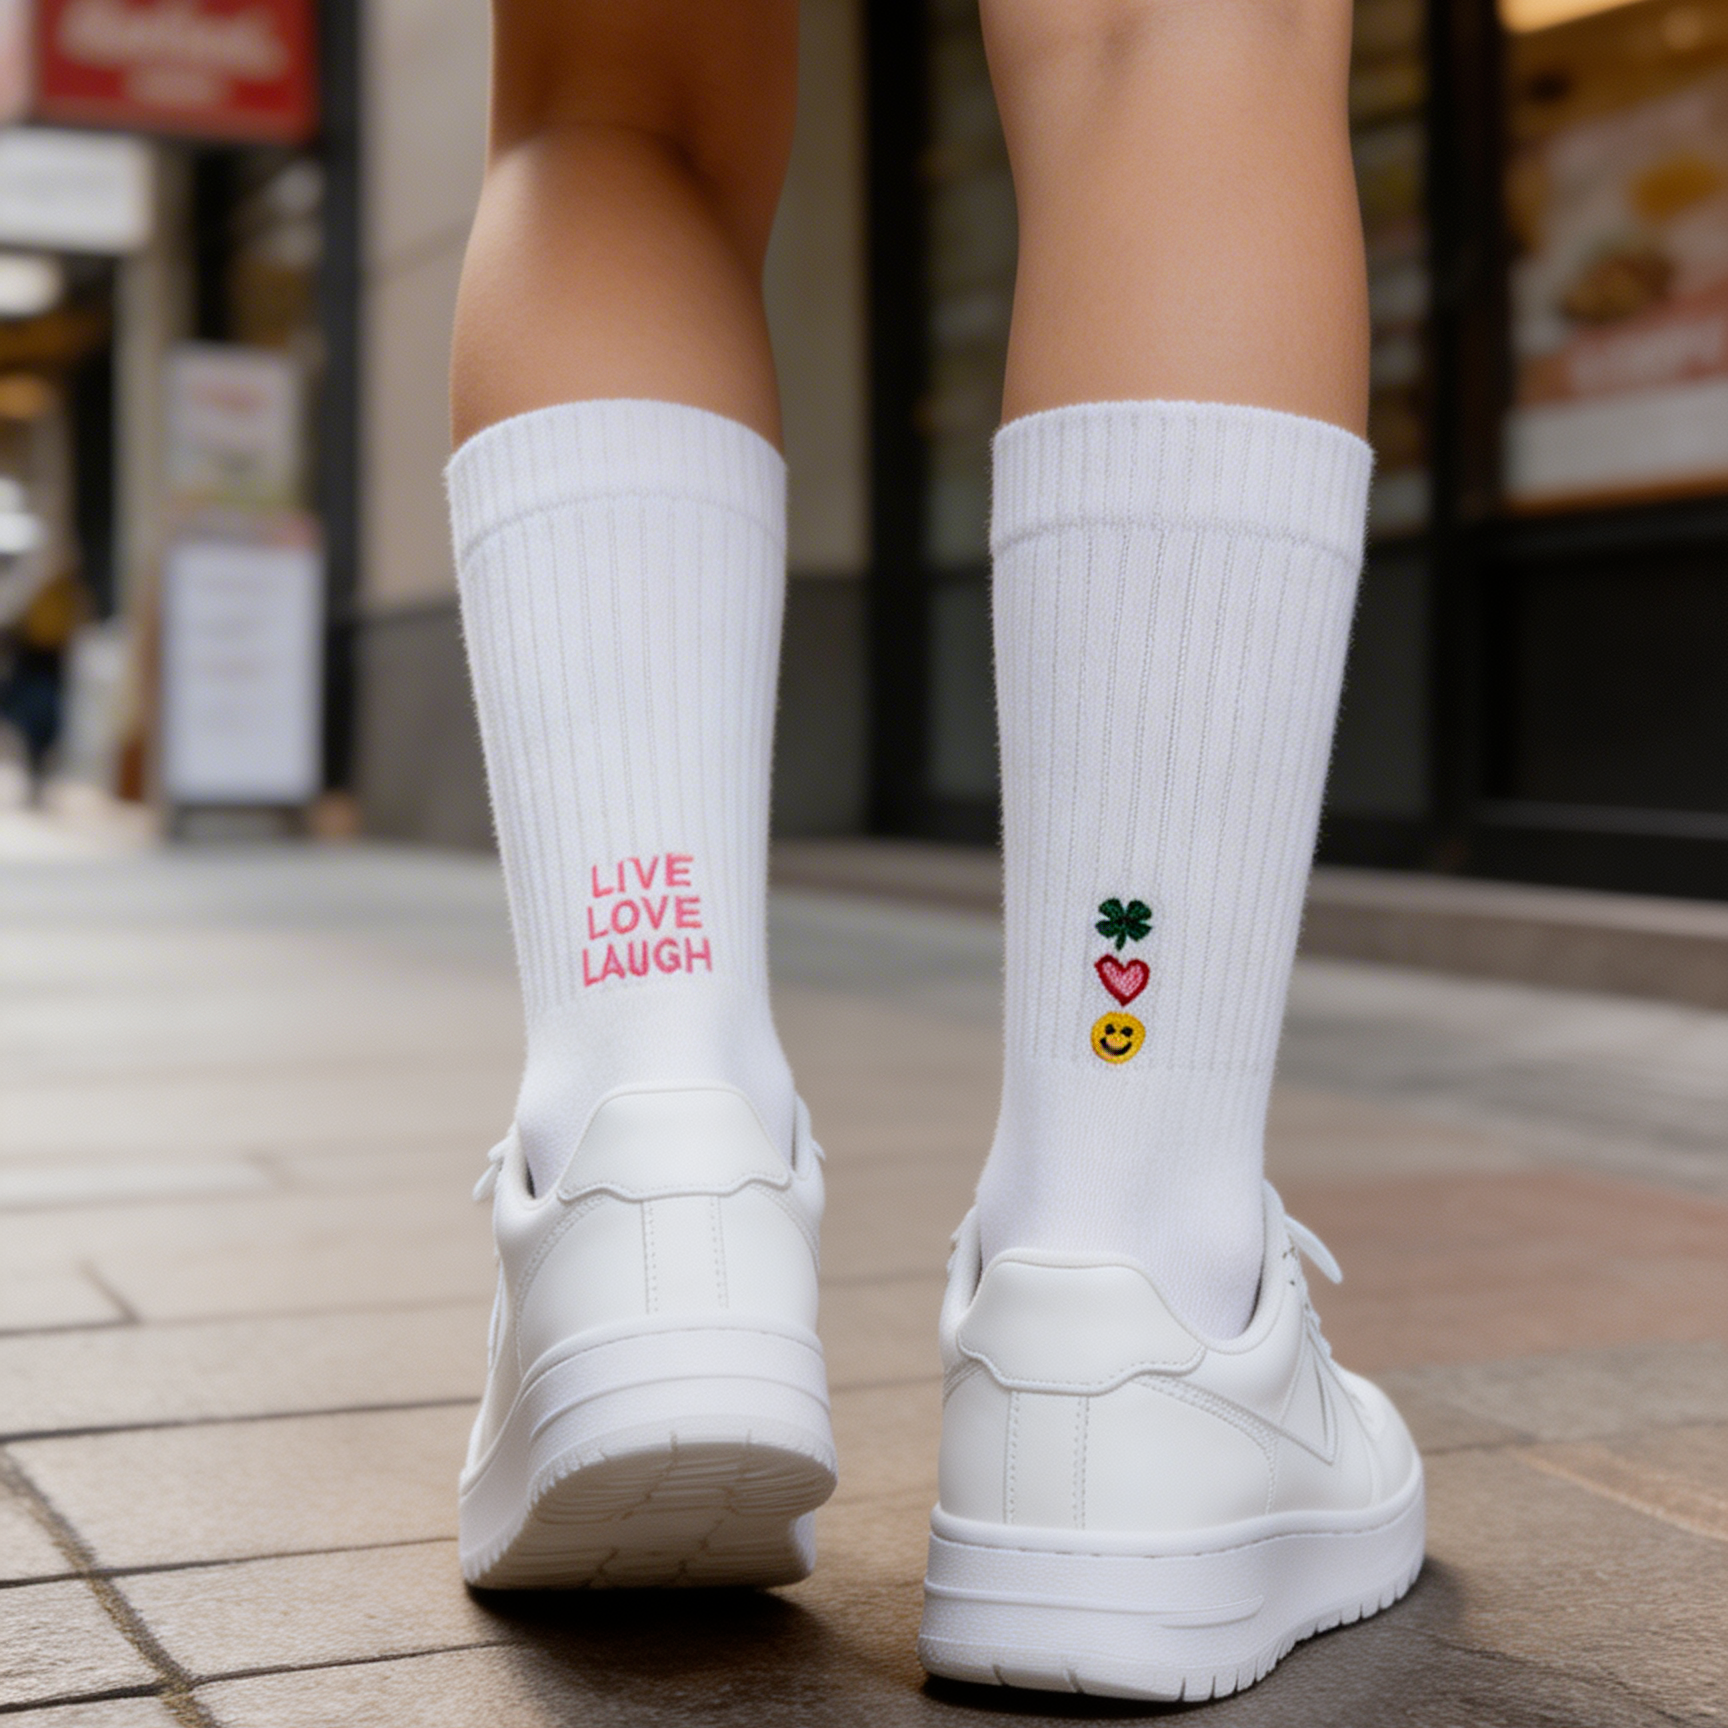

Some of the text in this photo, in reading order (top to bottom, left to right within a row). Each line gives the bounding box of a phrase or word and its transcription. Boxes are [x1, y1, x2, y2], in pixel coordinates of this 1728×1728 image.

[591, 852, 694, 899] LIVE
[586, 894, 703, 941] LOVE
[581, 936, 713, 988] LAUGH
